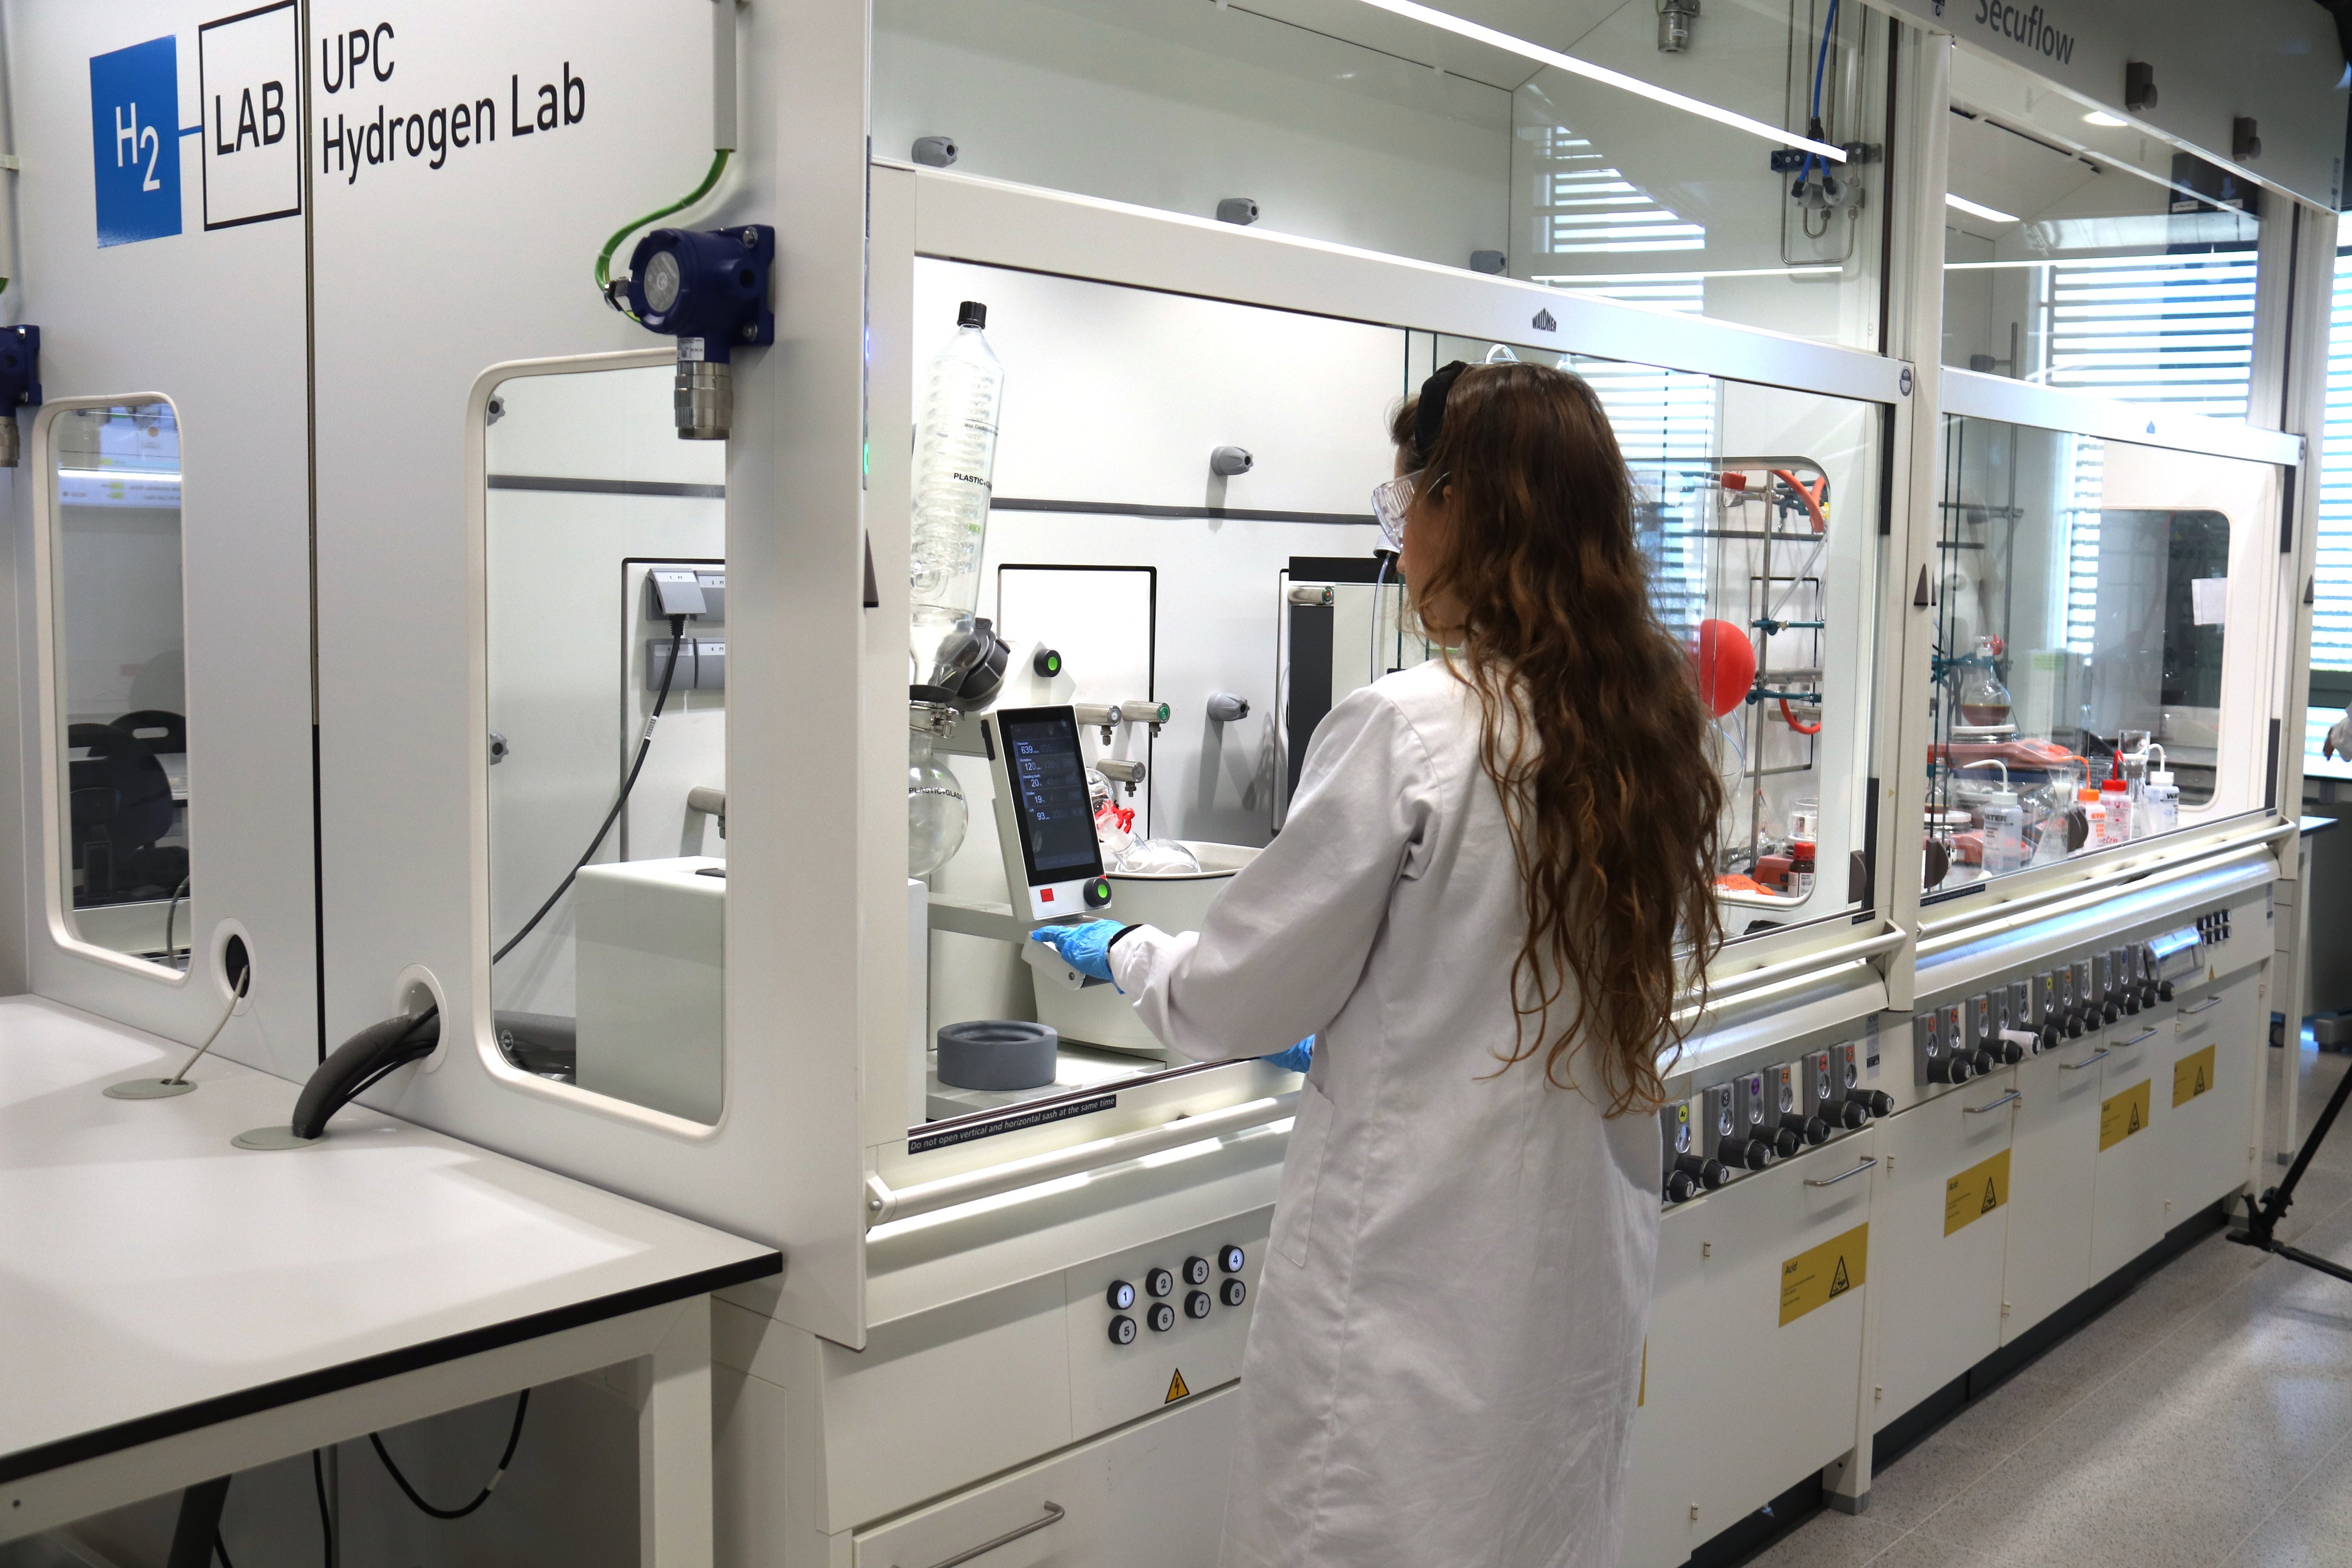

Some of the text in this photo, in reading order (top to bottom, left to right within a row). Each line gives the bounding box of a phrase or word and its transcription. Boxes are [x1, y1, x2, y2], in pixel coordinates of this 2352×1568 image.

[322, 21, 395, 94] UPC
[215, 80, 286, 156] LAB
[323, 61, 586, 185] Hydrogen Lab
[1532, 307, 1556, 333] WALDNER
[1021, 745, 1033, 754] 639
[1025, 762, 1036, 770] 120
[1035, 795, 1042, 803] 19
[1037, 812, 1046, 820] 93
[911, 1141, 922, 1151] Do
[923, 1138, 937, 1147] not
[939, 1134, 958, 1145] open
[960, 1127, 987, 1139] vertical
[988, 1123, 1003, 1133] and
[1004, 1114, 1041, 1129] horizontal
[1042, 1110, 1057, 1120] sash
[1068, 1106, 1079, 1114] the
[1081, 1103, 1098, 1112] same
[1099, 1097, 1115, 1107] time
[1233, 1255, 1238, 1265] 4
[1197, 1267, 1203, 1276] 3
[1784, 1261, 1798, 1276] Acid
[1161, 1278, 1167, 1289] 2
[1123, 1291, 1128, 1301] 1
[1235, 1289, 1240, 1298] 8
[1199, 1300, 1205, 1310] 7
[1162, 1314, 1168, 1324] 6
[1124, 1326, 1130, 1336] 5
